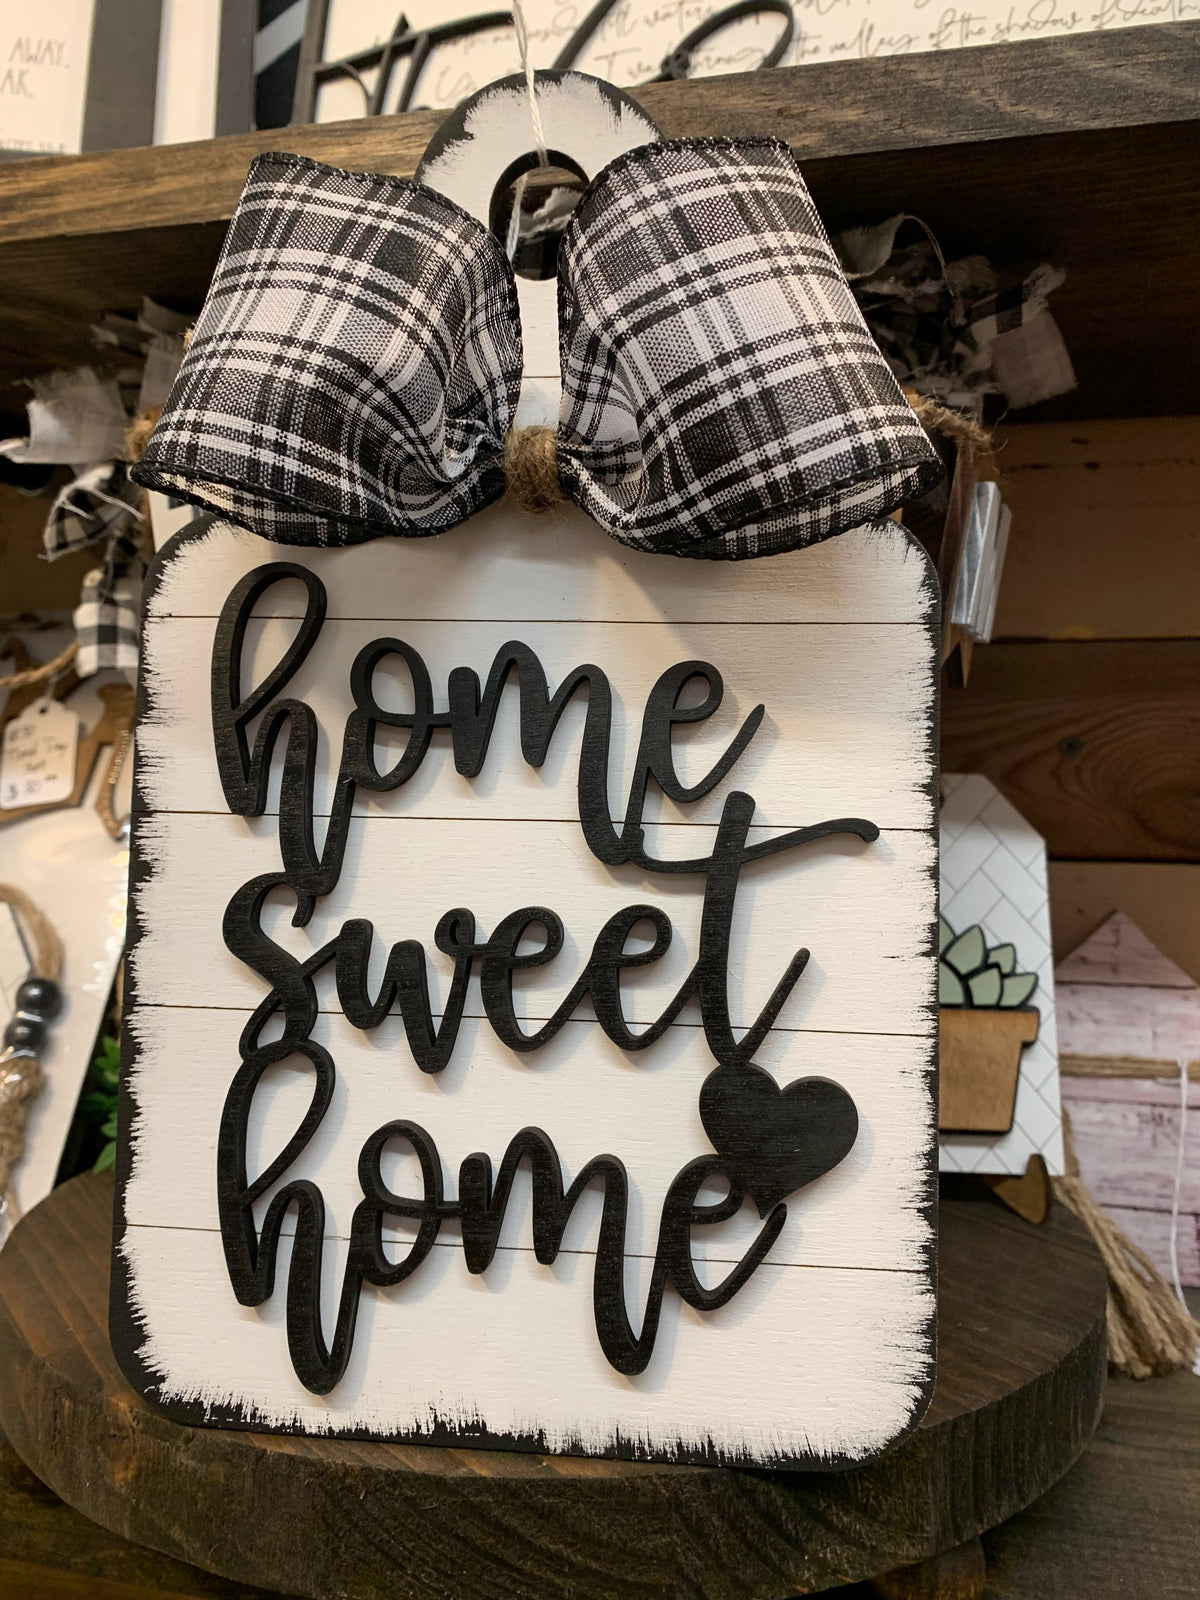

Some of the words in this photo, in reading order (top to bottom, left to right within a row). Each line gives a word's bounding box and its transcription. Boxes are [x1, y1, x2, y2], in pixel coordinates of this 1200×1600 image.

[211, 561, 765, 896] home
[222, 791, 880, 1073] sweet
[217, 1037, 788, 1396] home
